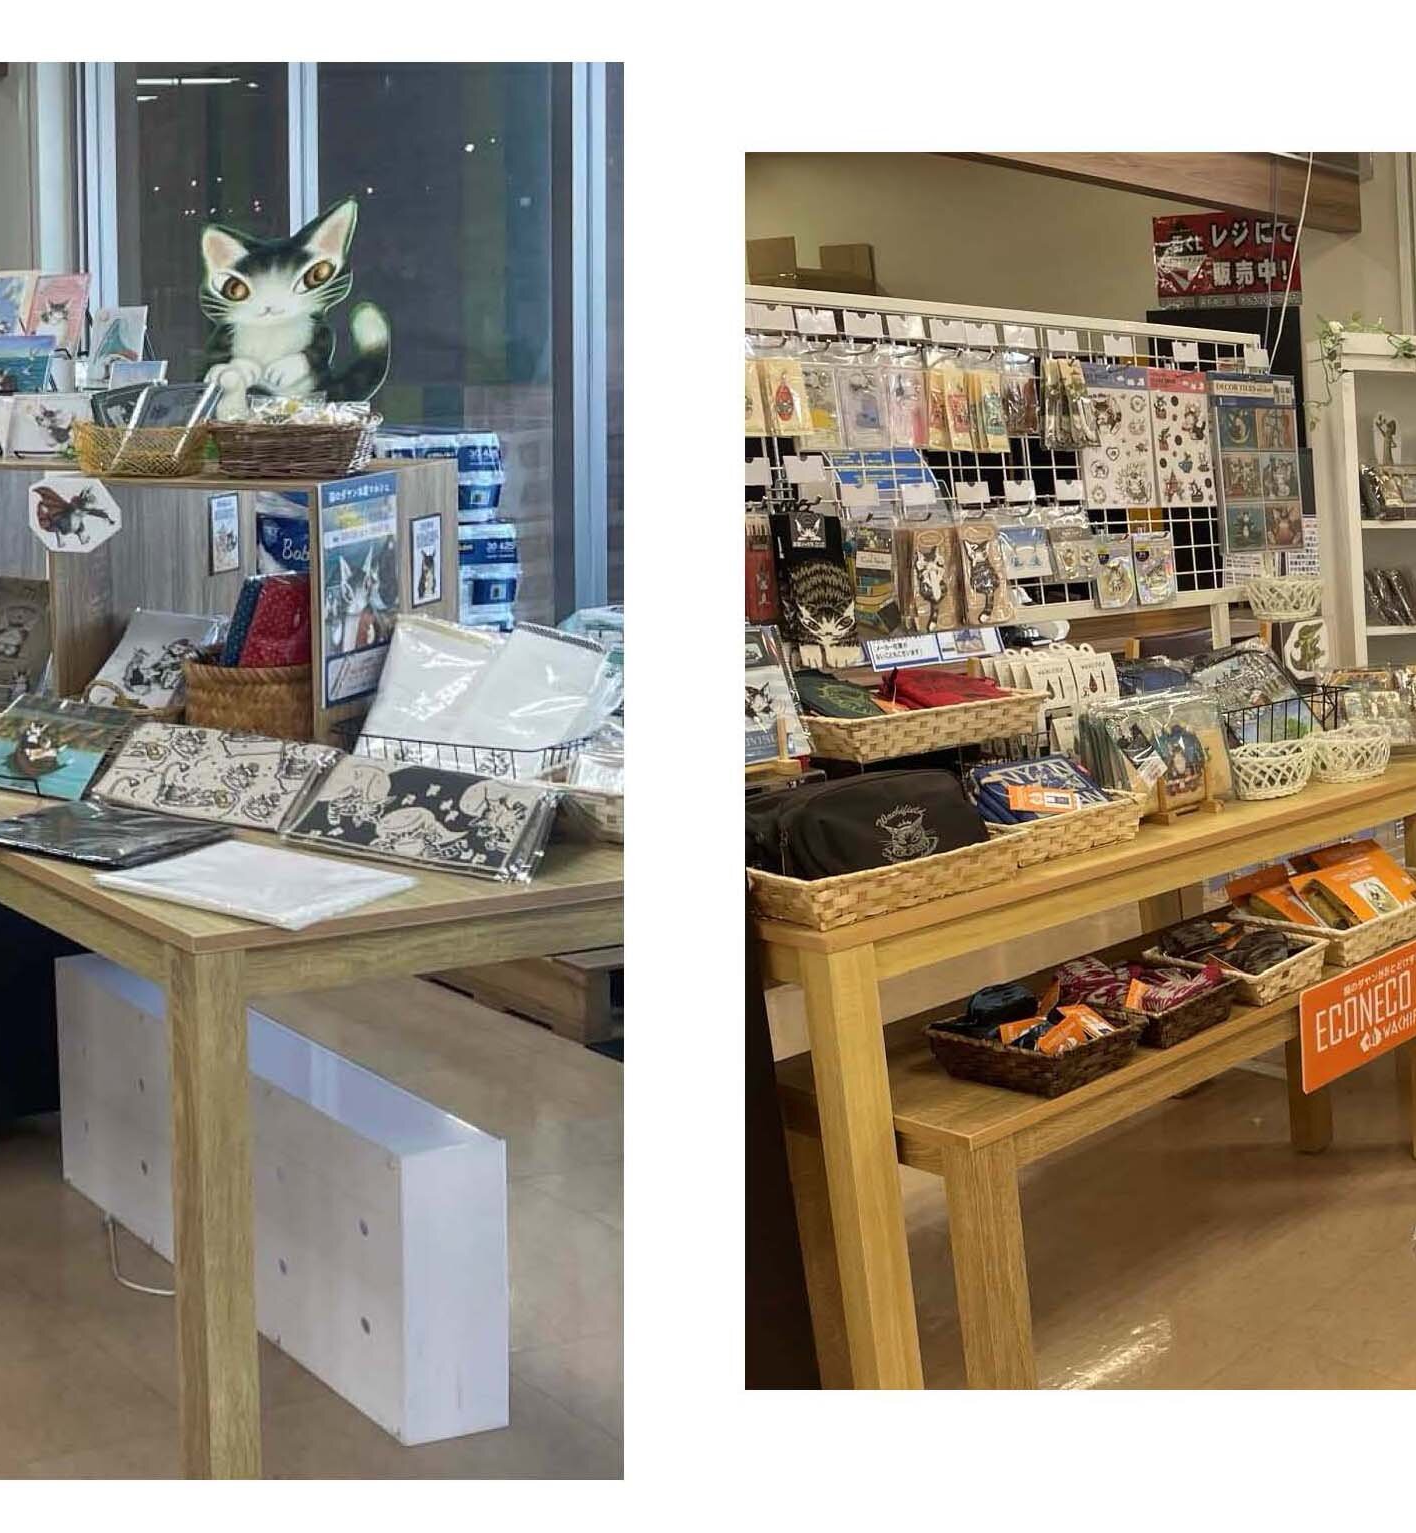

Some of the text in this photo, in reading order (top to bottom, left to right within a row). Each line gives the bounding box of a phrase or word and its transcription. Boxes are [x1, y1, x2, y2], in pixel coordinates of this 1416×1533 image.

[1211, 221, 1297, 249] レジにて
[1316, 971, 1411, 1053] ECONECO
